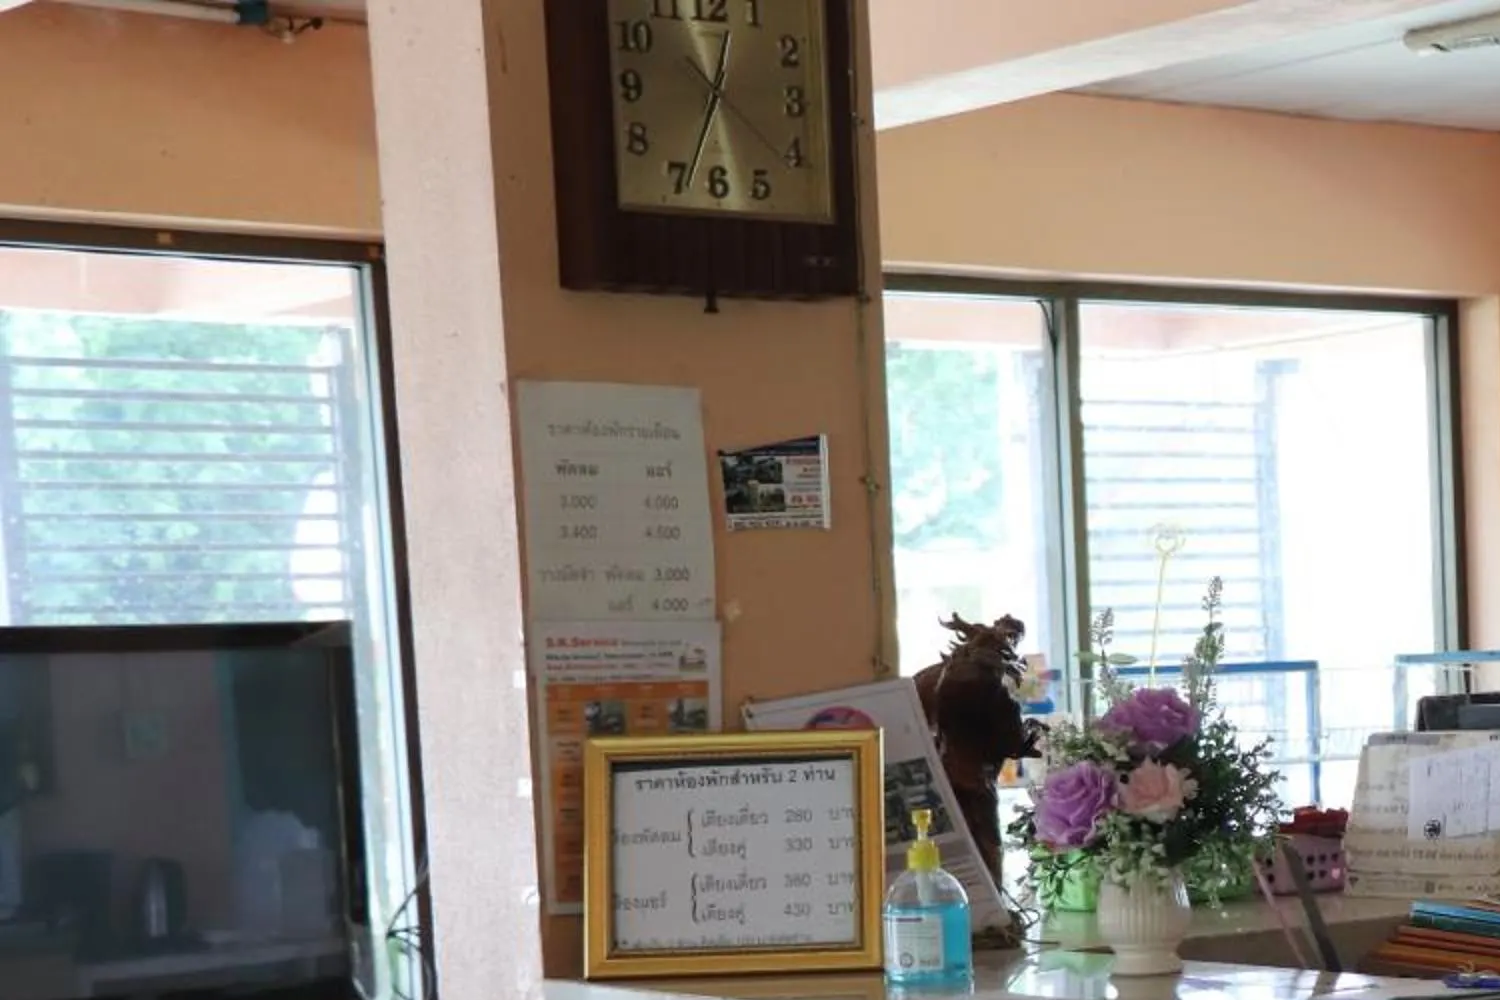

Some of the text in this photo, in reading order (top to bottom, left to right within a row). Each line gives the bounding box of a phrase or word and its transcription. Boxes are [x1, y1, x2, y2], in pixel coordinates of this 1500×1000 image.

[616, 20, 652, 51] 10
[779, 35, 800, 67] 2
[619, 69, 643, 102] 9
[784, 86, 805, 117] 3
[627, 123, 648, 155] 8
[783, 138, 803, 167] 4
[667, 162, 689, 194] 7
[708, 166, 729, 198] 6
[751, 170, 771, 199] 5
[635, 765, 835, 790] ราคาห้องพักสำหรับ 2 ท่าน
